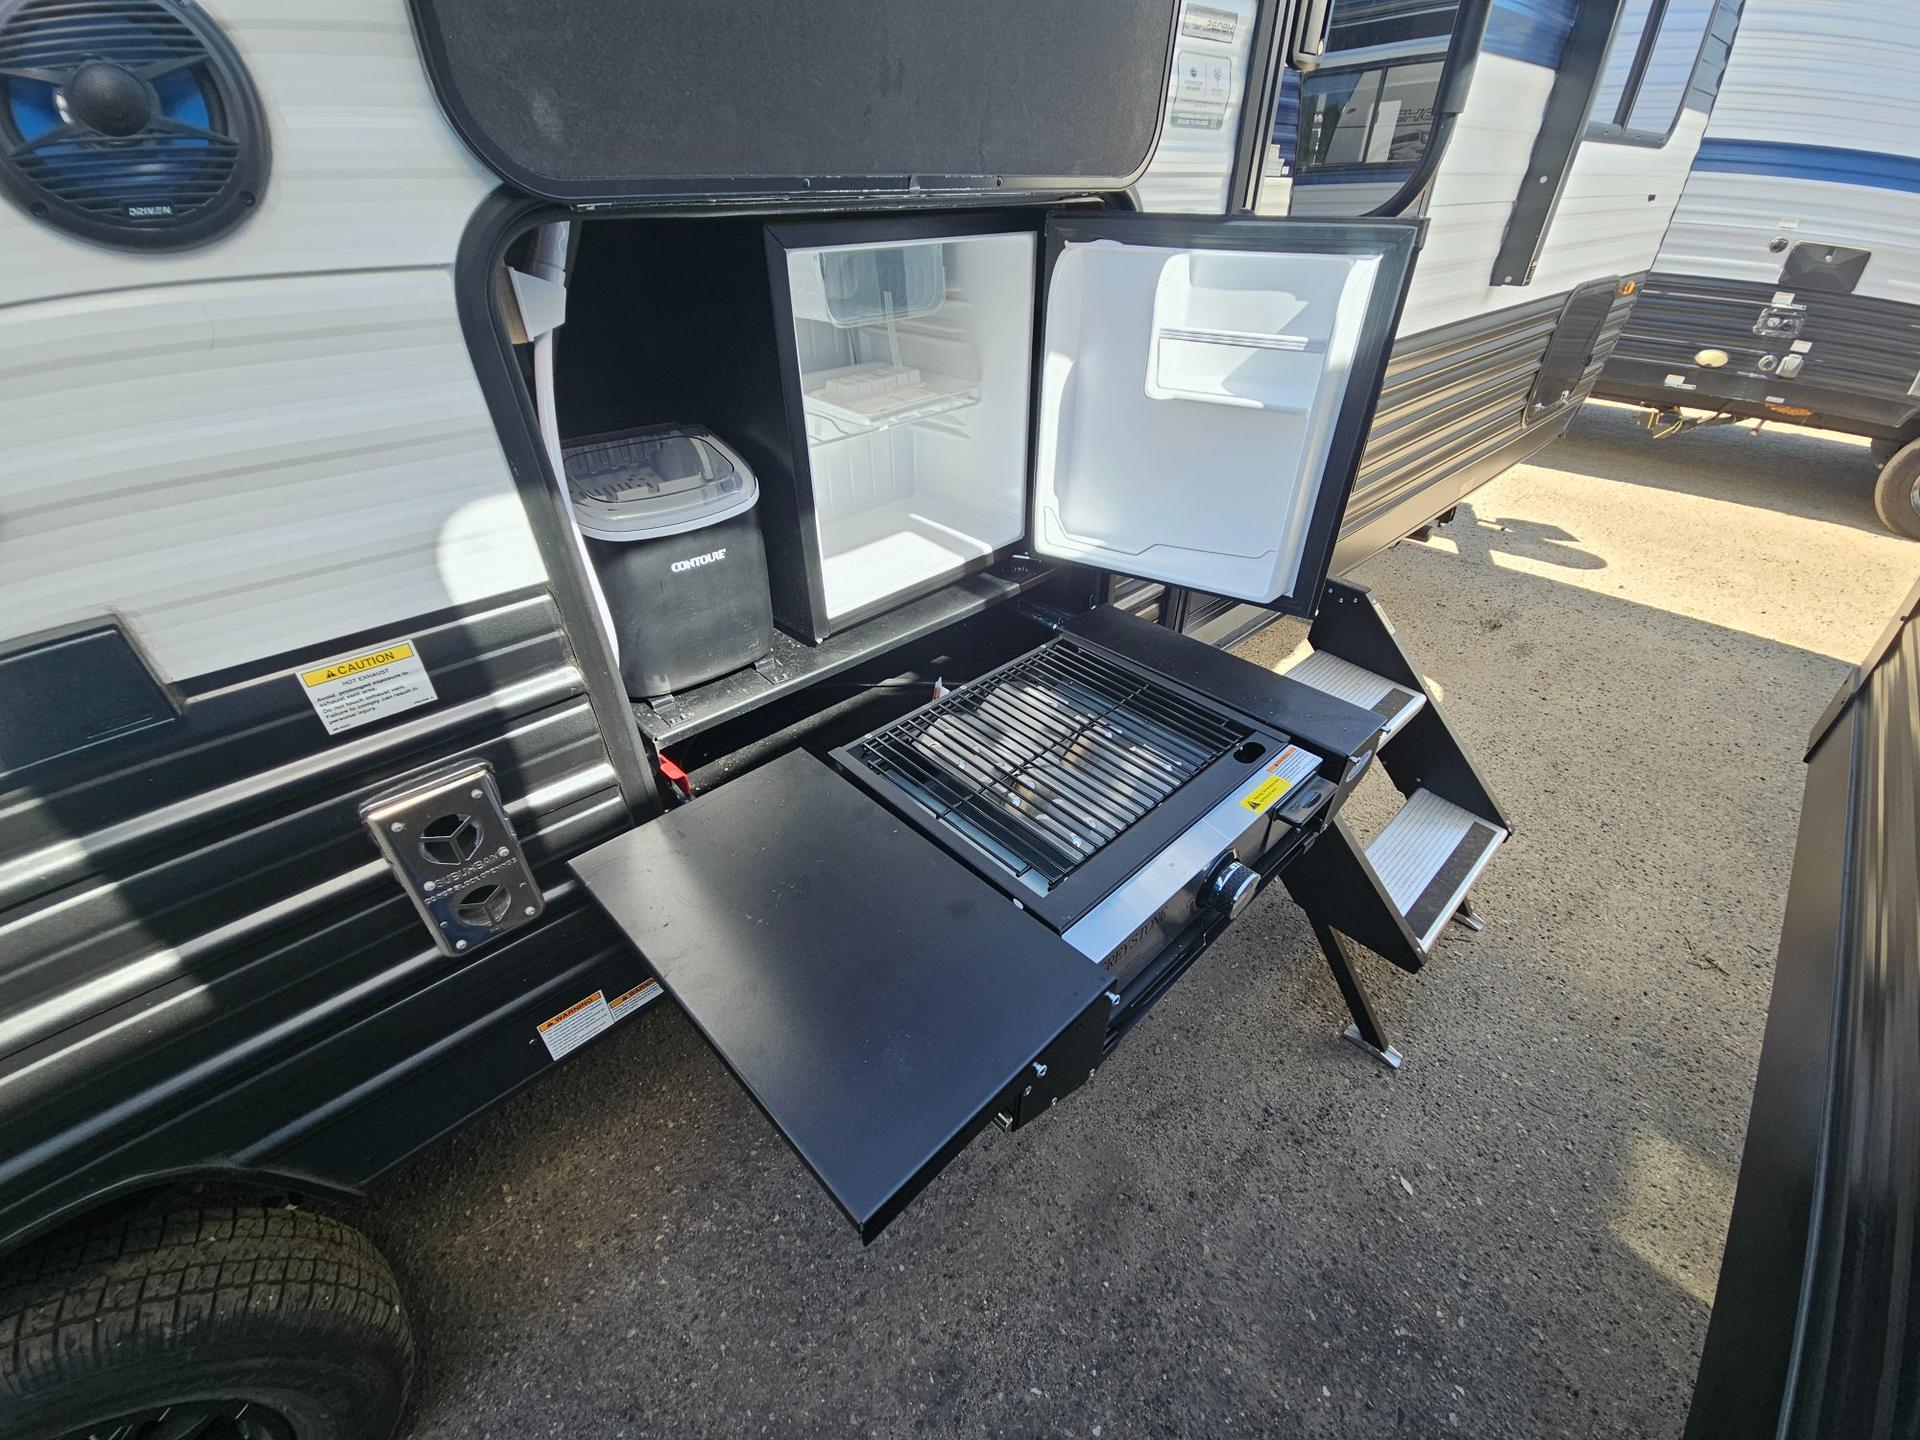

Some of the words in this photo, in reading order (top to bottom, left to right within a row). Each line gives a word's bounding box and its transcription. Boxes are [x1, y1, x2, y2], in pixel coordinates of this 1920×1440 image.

[128, 206, 172, 217] DRIVEN
[671, 548, 727, 573] CONTOURE
[337, 651, 394, 675] CAUTION
[342, 678, 356, 687] HOT
[358, 668, 388, 681] EXHAUST
[317, 693, 336, 702] Avoid
[555, 998, 593, 1022] WARNING
